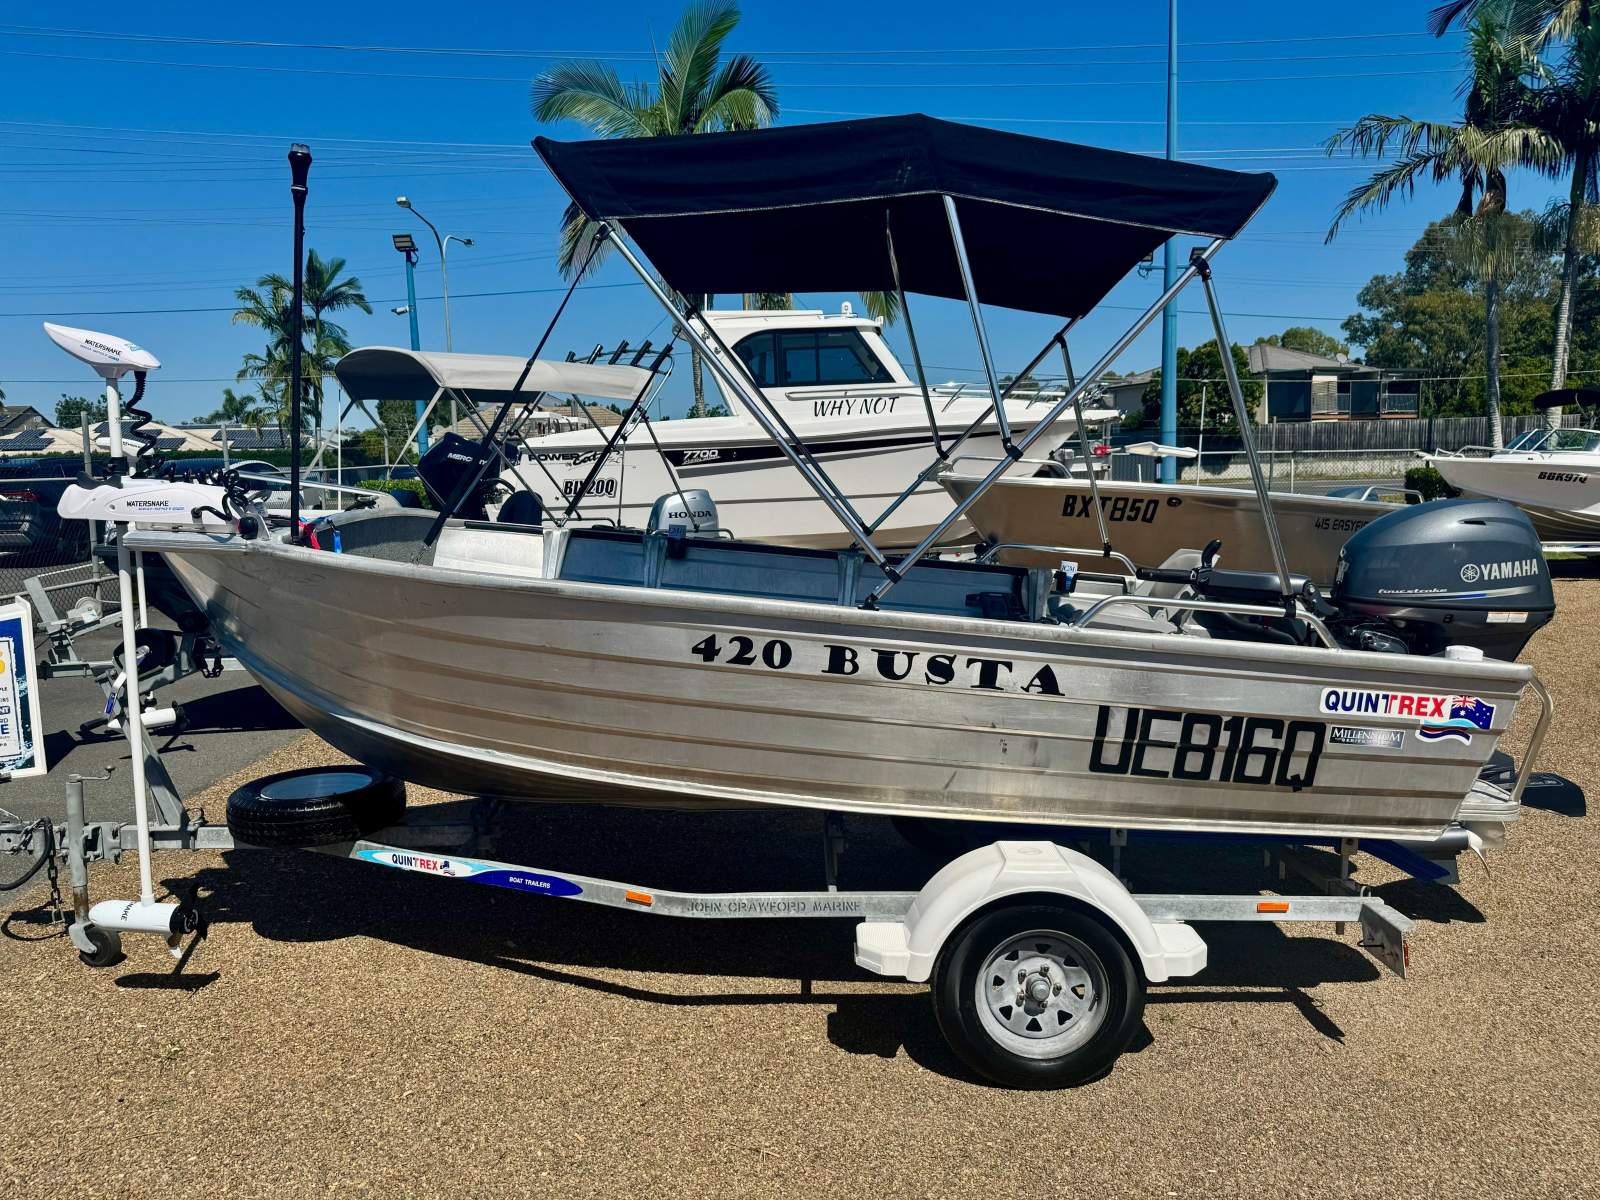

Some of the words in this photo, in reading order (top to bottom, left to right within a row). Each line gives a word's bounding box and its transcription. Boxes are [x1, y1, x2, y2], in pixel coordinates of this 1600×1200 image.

[85, 339, 123, 356] WATERSNAKE
[814, 399, 857, 417] WHY
[859, 396, 900, 415] NOT
[126, 500, 169, 508] WATERSNAKE
[668, 510, 713, 520] HONDA
[1481, 558, 1540, 581] YAMAHA
[691, 633, 794, 671] 420
[821, 644, 1067, 697] BUSTA
[1324, 689, 1447, 718] QUINTREX
[1088, 704, 1327, 792] UE816Q
[391, 852, 439, 872] QUINTREX
[509, 876, 523, 885] BOAT
[524, 878, 551, 889] TRAILERS
[688, 901, 722, 912] JOHN
[727, 901, 807, 912] CRAWFORD
[812, 901, 860, 912] MARINE
